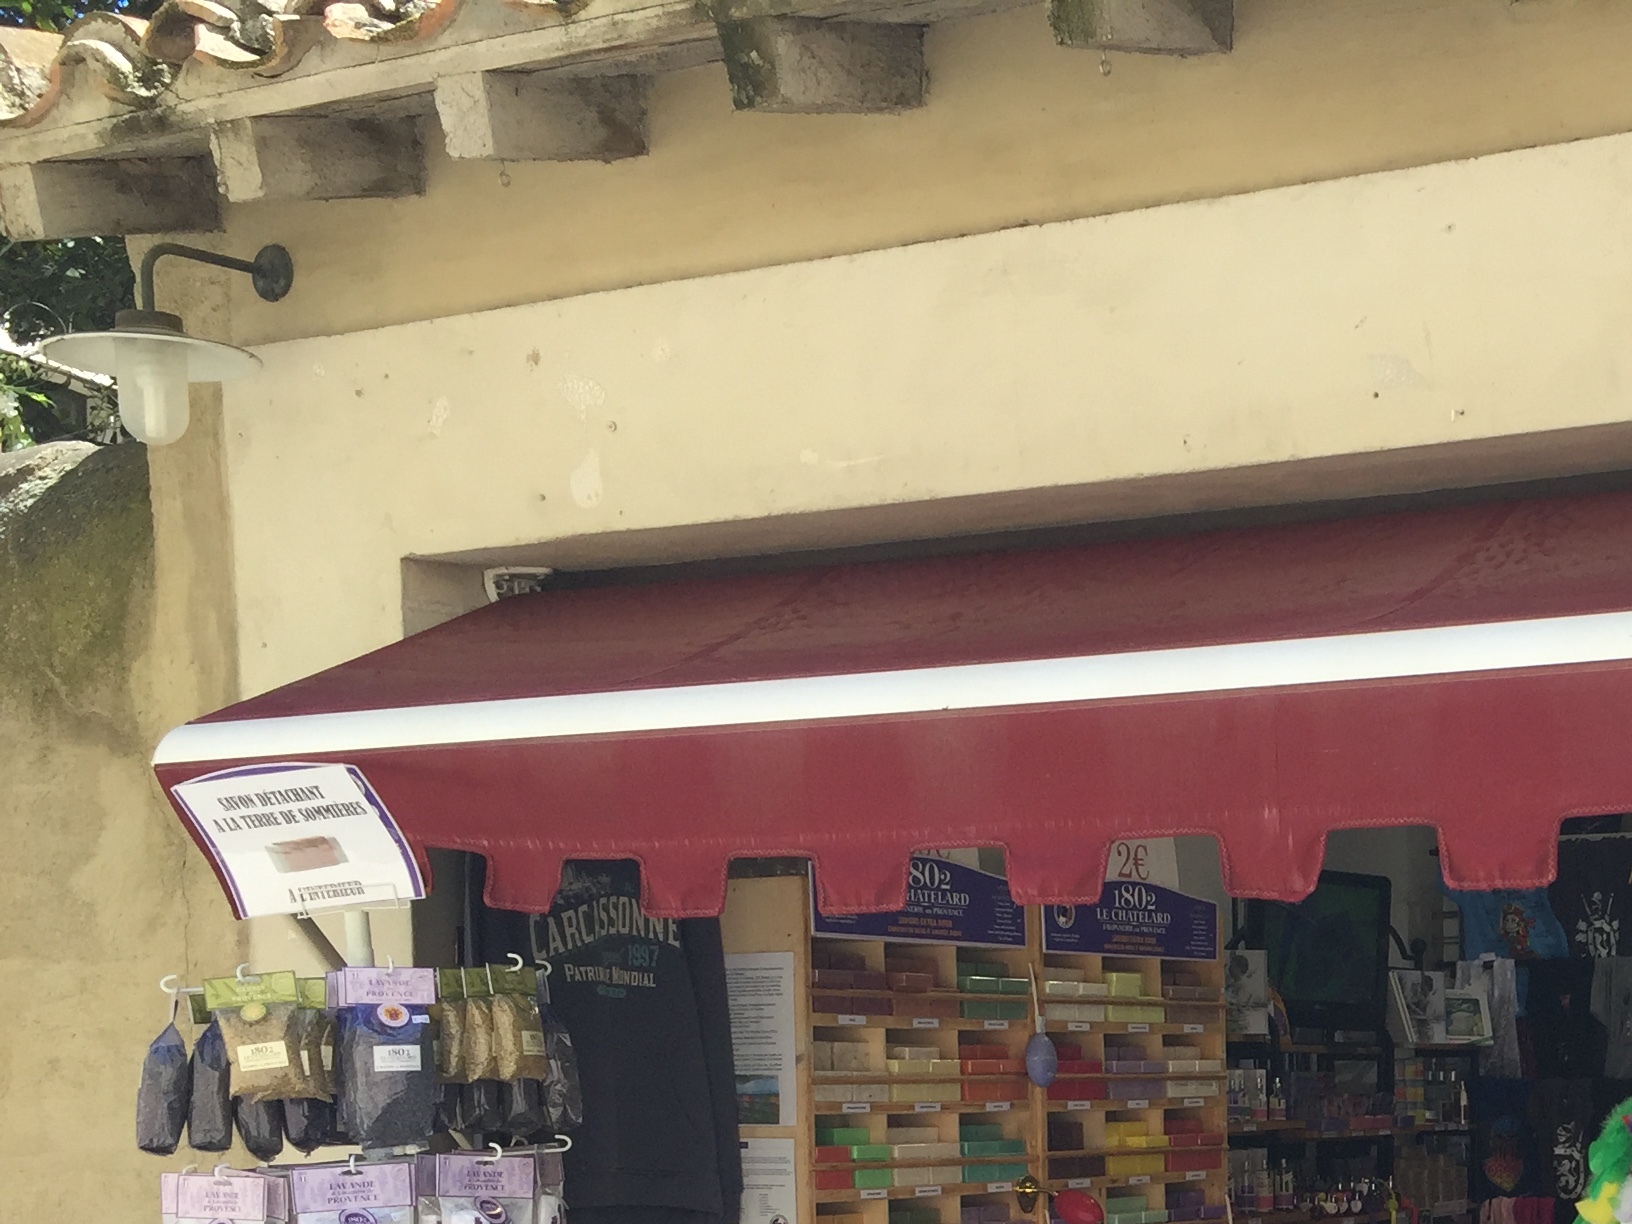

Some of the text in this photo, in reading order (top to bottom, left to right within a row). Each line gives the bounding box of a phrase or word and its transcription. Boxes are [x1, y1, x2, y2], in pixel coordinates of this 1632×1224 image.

[217, 786, 326, 811] SAVON DÉTACHANT
[213, 801, 368, 833] A LA TERRE DE SOMMIÈRES
[1117, 842, 1150, 880] 2€
[1114, 884, 1156, 910] 1802
[1112, 909, 1171, 924] CHATELARD
